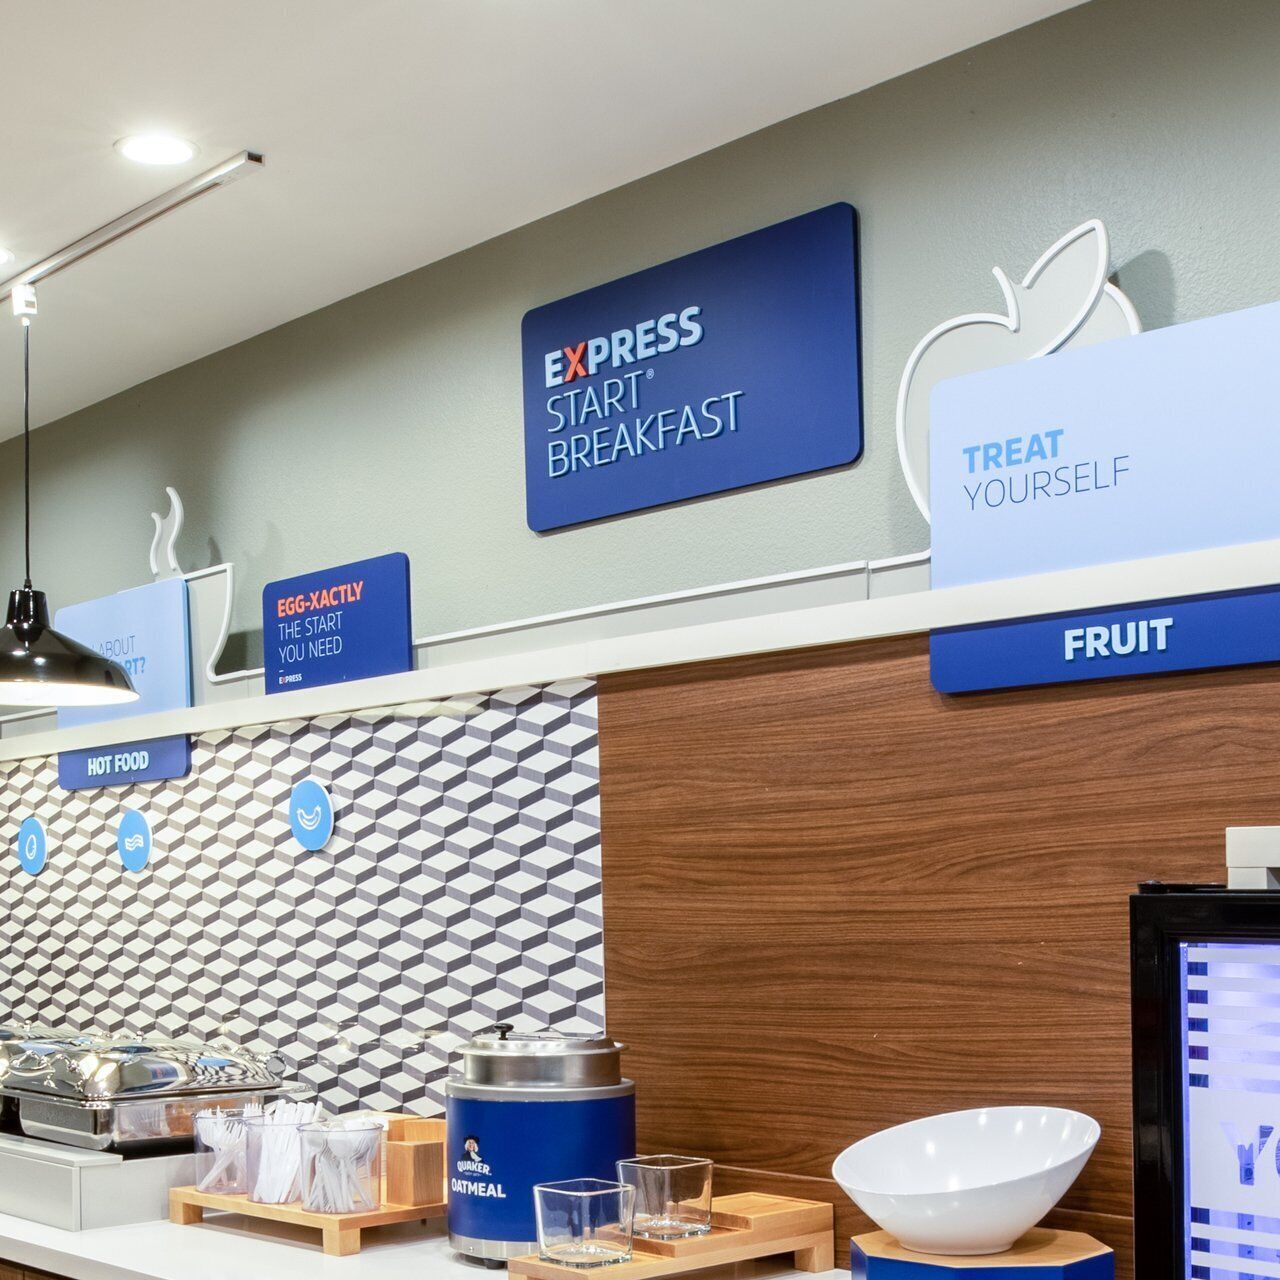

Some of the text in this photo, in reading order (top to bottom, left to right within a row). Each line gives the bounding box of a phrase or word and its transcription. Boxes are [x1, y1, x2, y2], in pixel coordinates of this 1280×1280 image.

[545, 306, 704, 388] EXPRESS
[548, 391, 745, 478] BREAKFAST
[963, 429, 1064, 474] TREAT
[964, 455, 1129, 510] YOURSELF
[277, 581, 364, 618] EGG-XACTLY
[278, 611, 343, 640] THE START
[1064, 617, 1174, 661] FRUIT
[278, 636, 343, 663] YOU NEED
[124, 657, 146, 676] RT?
[278, 674, 302, 684] EXPRESS
[87, 750, 149, 776] HOT FOOD
[456, 1160, 490, 1175] QUAKER
[451, 1177, 507, 1198] OATMEAL
